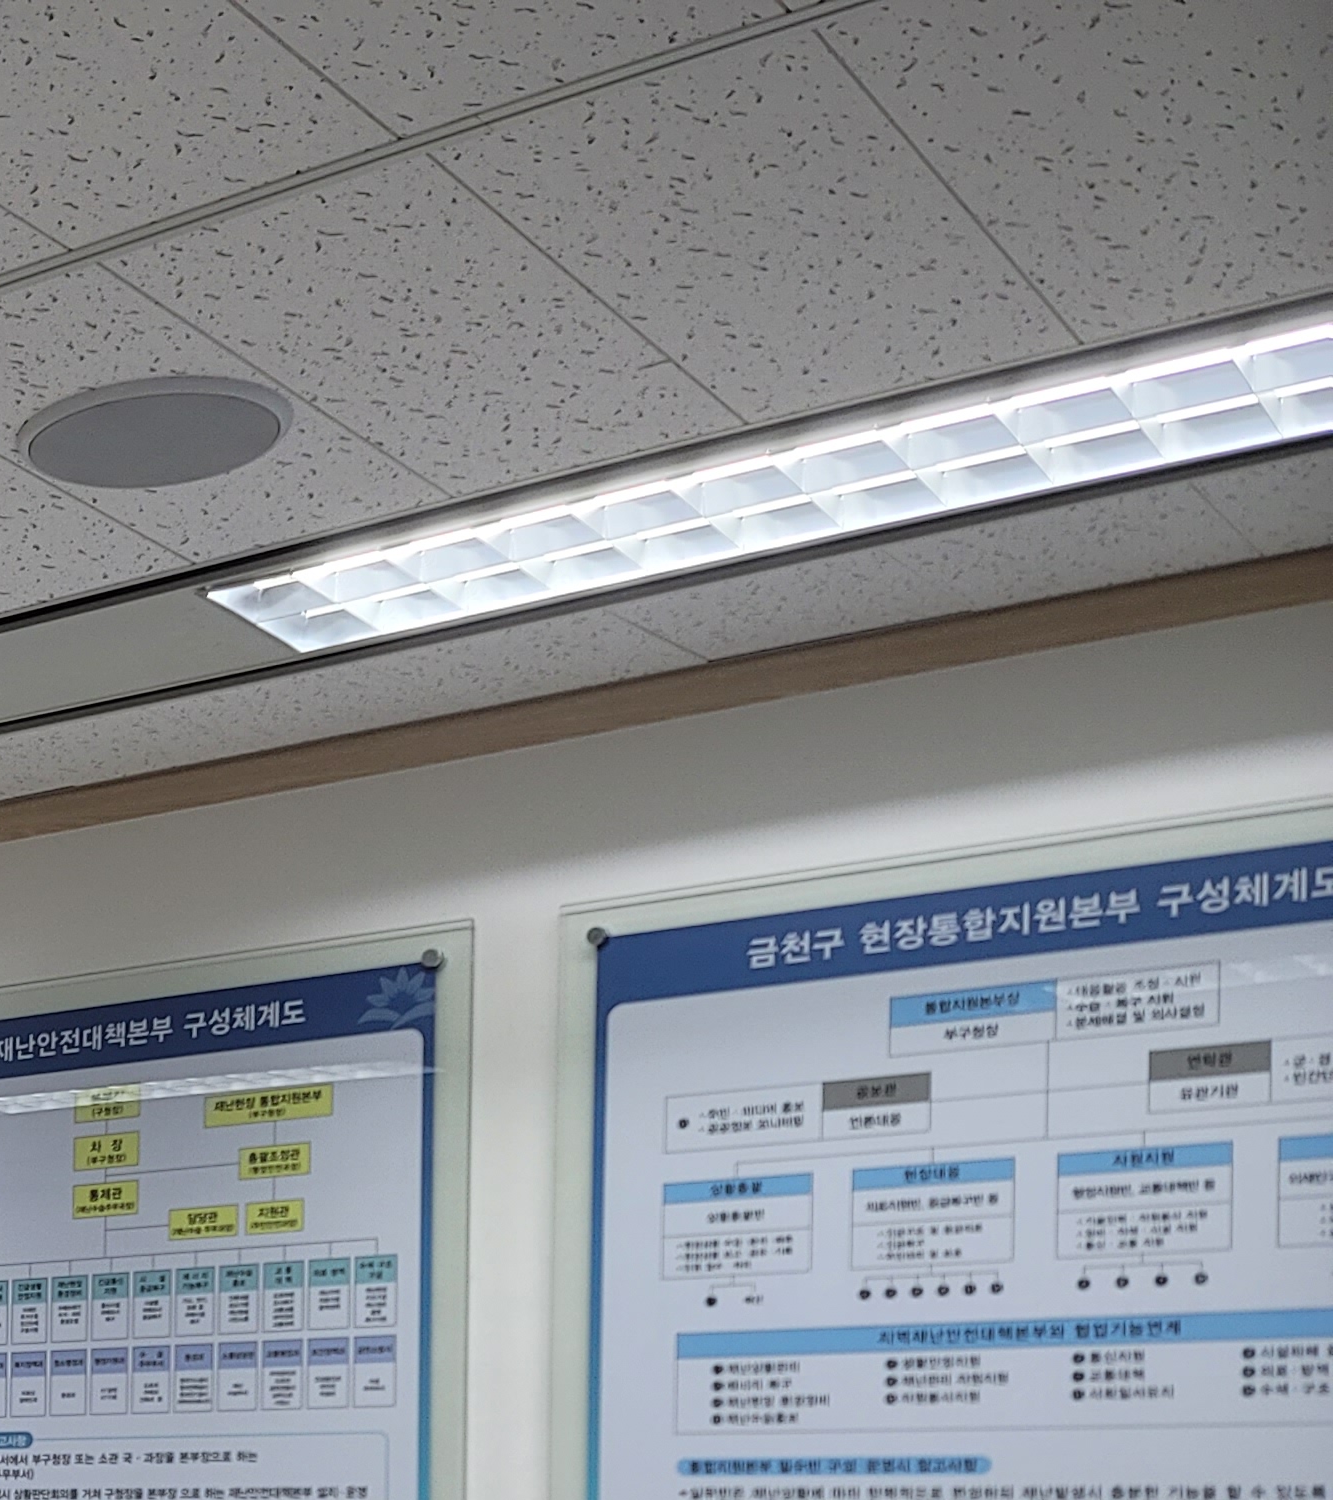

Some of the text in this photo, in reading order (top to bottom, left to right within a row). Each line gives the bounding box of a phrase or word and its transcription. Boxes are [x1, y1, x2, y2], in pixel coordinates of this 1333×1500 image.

[745, 929, 846, 971] 금천구
[859, 886, 1141, 955] 현장통합지원본부
[184, 998, 307, 1040] 구성체계도
